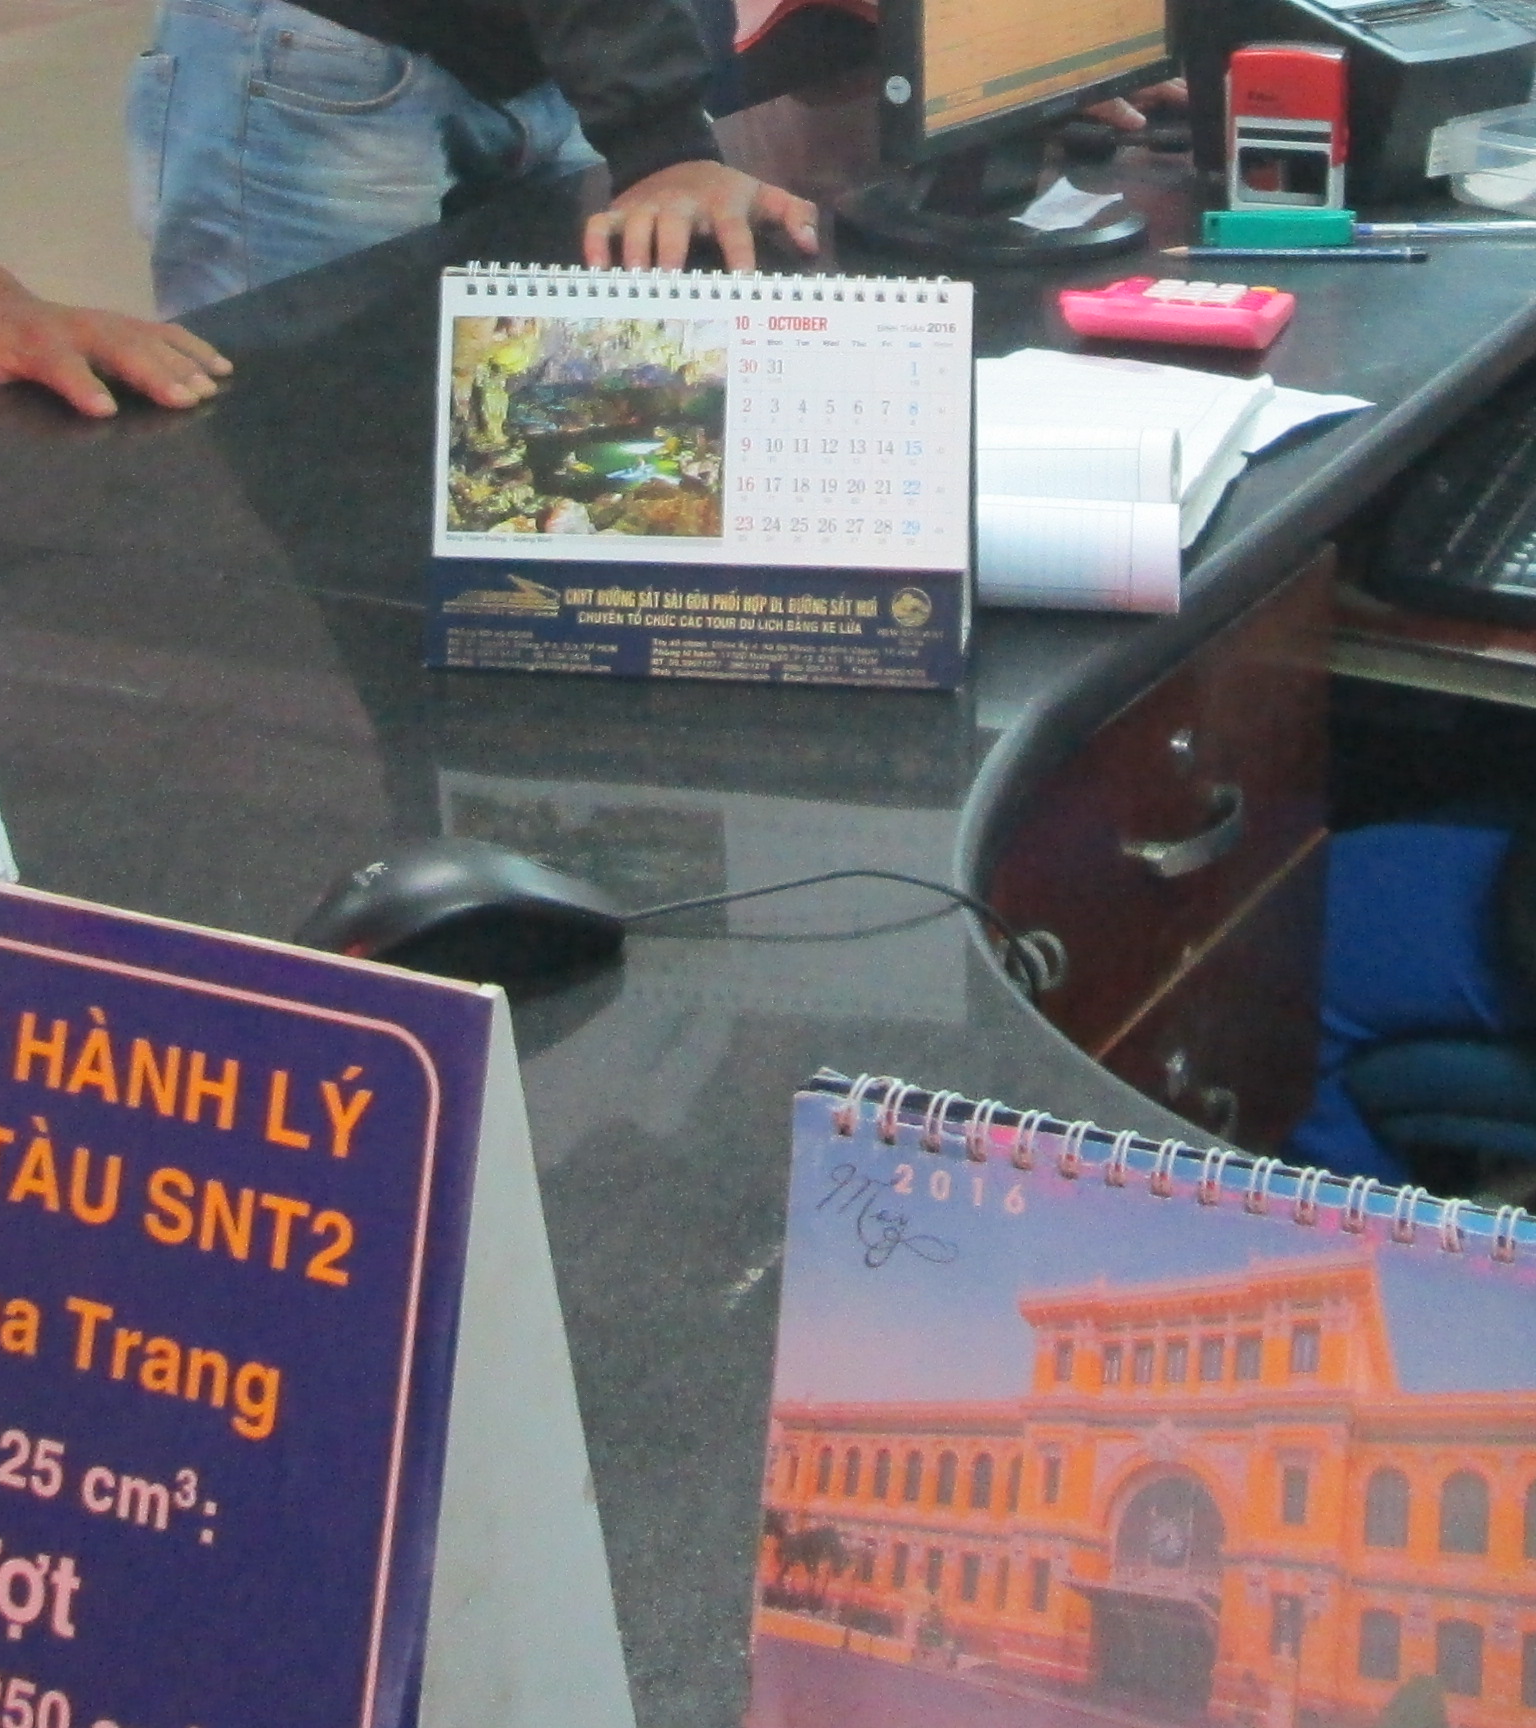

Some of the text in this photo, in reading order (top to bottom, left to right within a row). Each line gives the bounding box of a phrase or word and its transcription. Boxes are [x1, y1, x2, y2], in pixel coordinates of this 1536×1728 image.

[735, 315, 750, 330] 10
[768, 316, 828, 332] OCTOBER
[927, 323, 956, 333] 2016
[739, 359, 757, 374] 30
[767, 359, 783, 374] 31
[742, 398, 752, 413] 2
[770, 399, 779, 413] 3
[798, 399, 807, 413] 4
[825, 400, 836, 414] 5
[853, 400, 864, 415] 6
[882, 400, 891, 415] 7
[741, 437, 923, 456] 9 10 11 12 13 14 15
[737, 477, 754, 492] 16
[765, 477, 782, 492] 17
[792, 478, 810, 493] 18
[820, 478, 838, 494] 19
[847, 478, 866, 494] 20
[874, 479, 892, 495] 21
[762, 518, 781, 532] 24
[790, 518, 809, 533] 25
[818, 518, 837, 534] 26
[845, 518, 865, 533] 27
[874, 519, 893, 534] 28
[706, 615, 736, 630] TOUR
[822, 620, 837, 633] XE
[12, 1005, 241, 1132] HÀNH
[265, 1064, 374, 1160] LÝ
[893, 1163, 1026, 1215] 2016
[143, 1166, 356, 1289] SNT2
[64, 1294, 282, 1442] Trang
